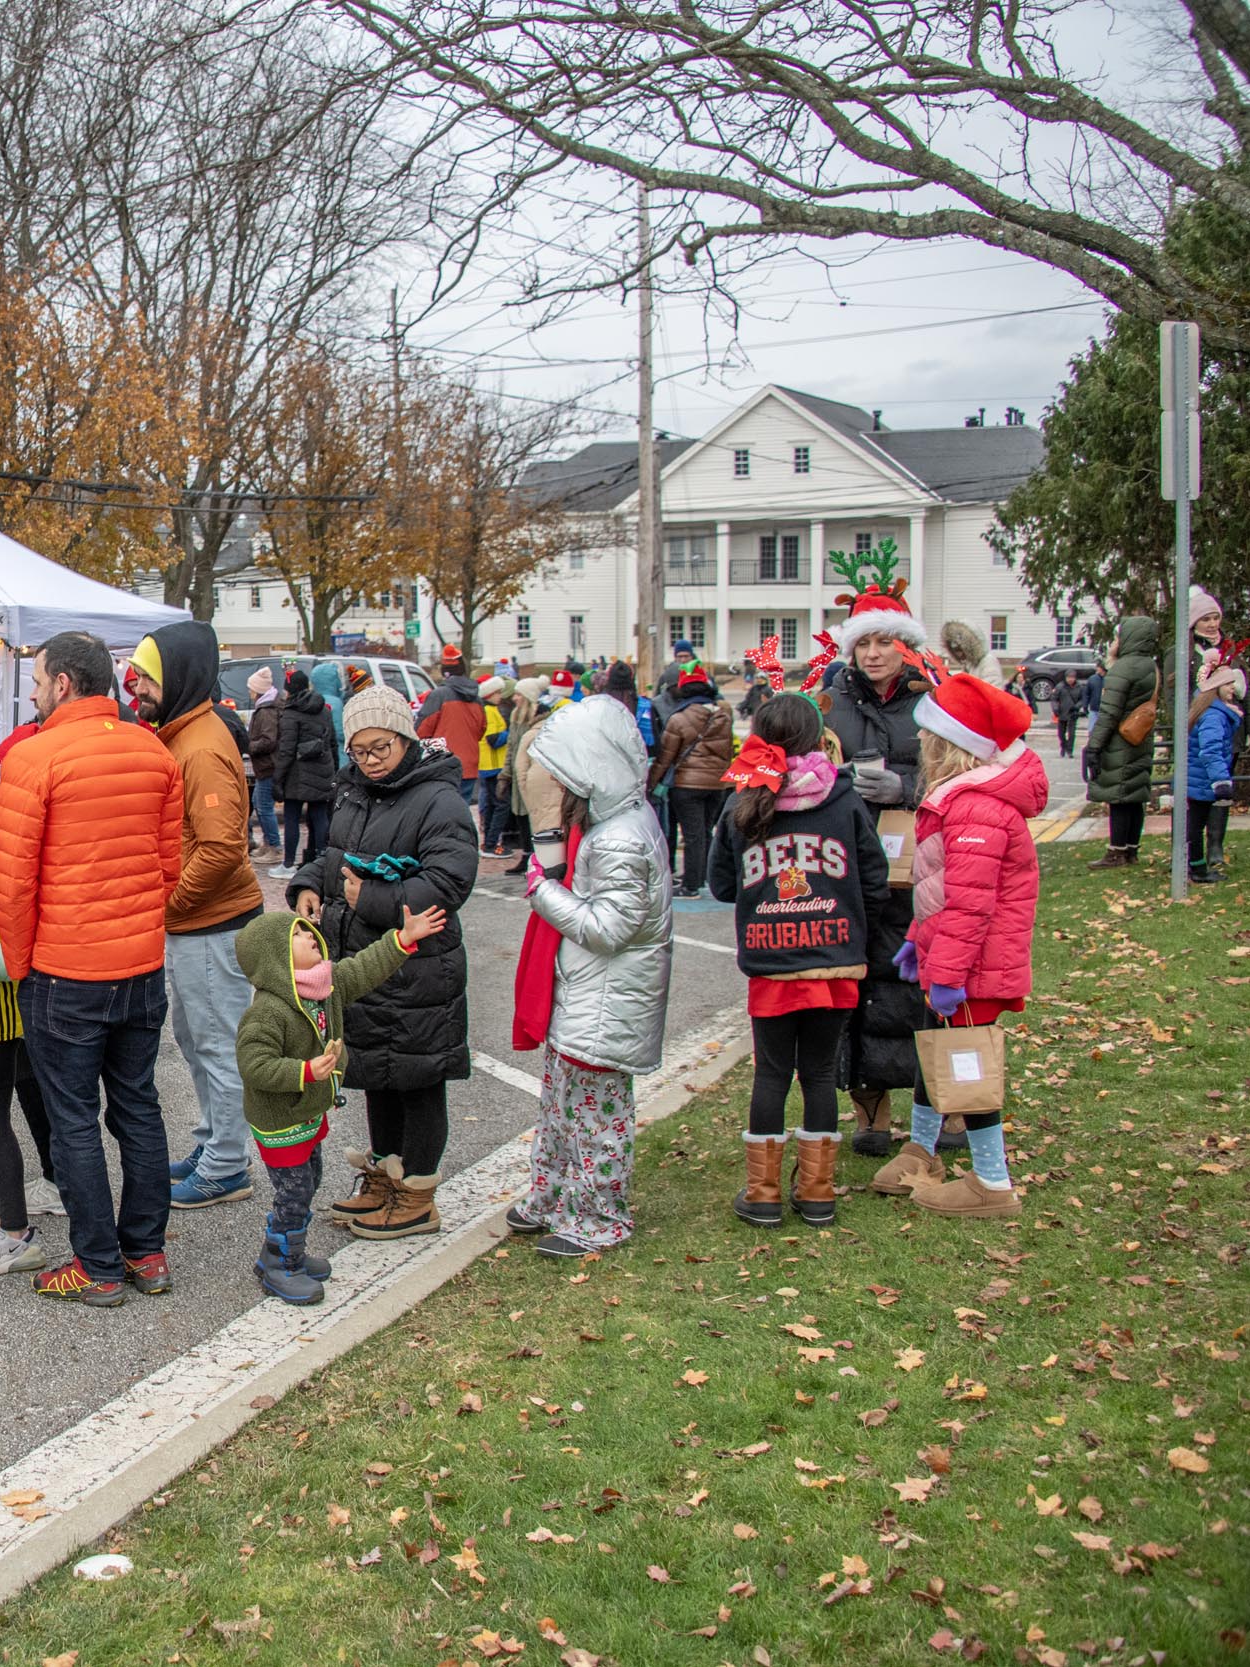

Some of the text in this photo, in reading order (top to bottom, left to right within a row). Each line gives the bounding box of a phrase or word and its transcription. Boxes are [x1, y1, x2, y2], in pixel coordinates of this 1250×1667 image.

[742, 833, 848, 889] BEES
[756, 897, 837, 914] cheerleading
[745, 917, 849, 949] BRUBAKER
